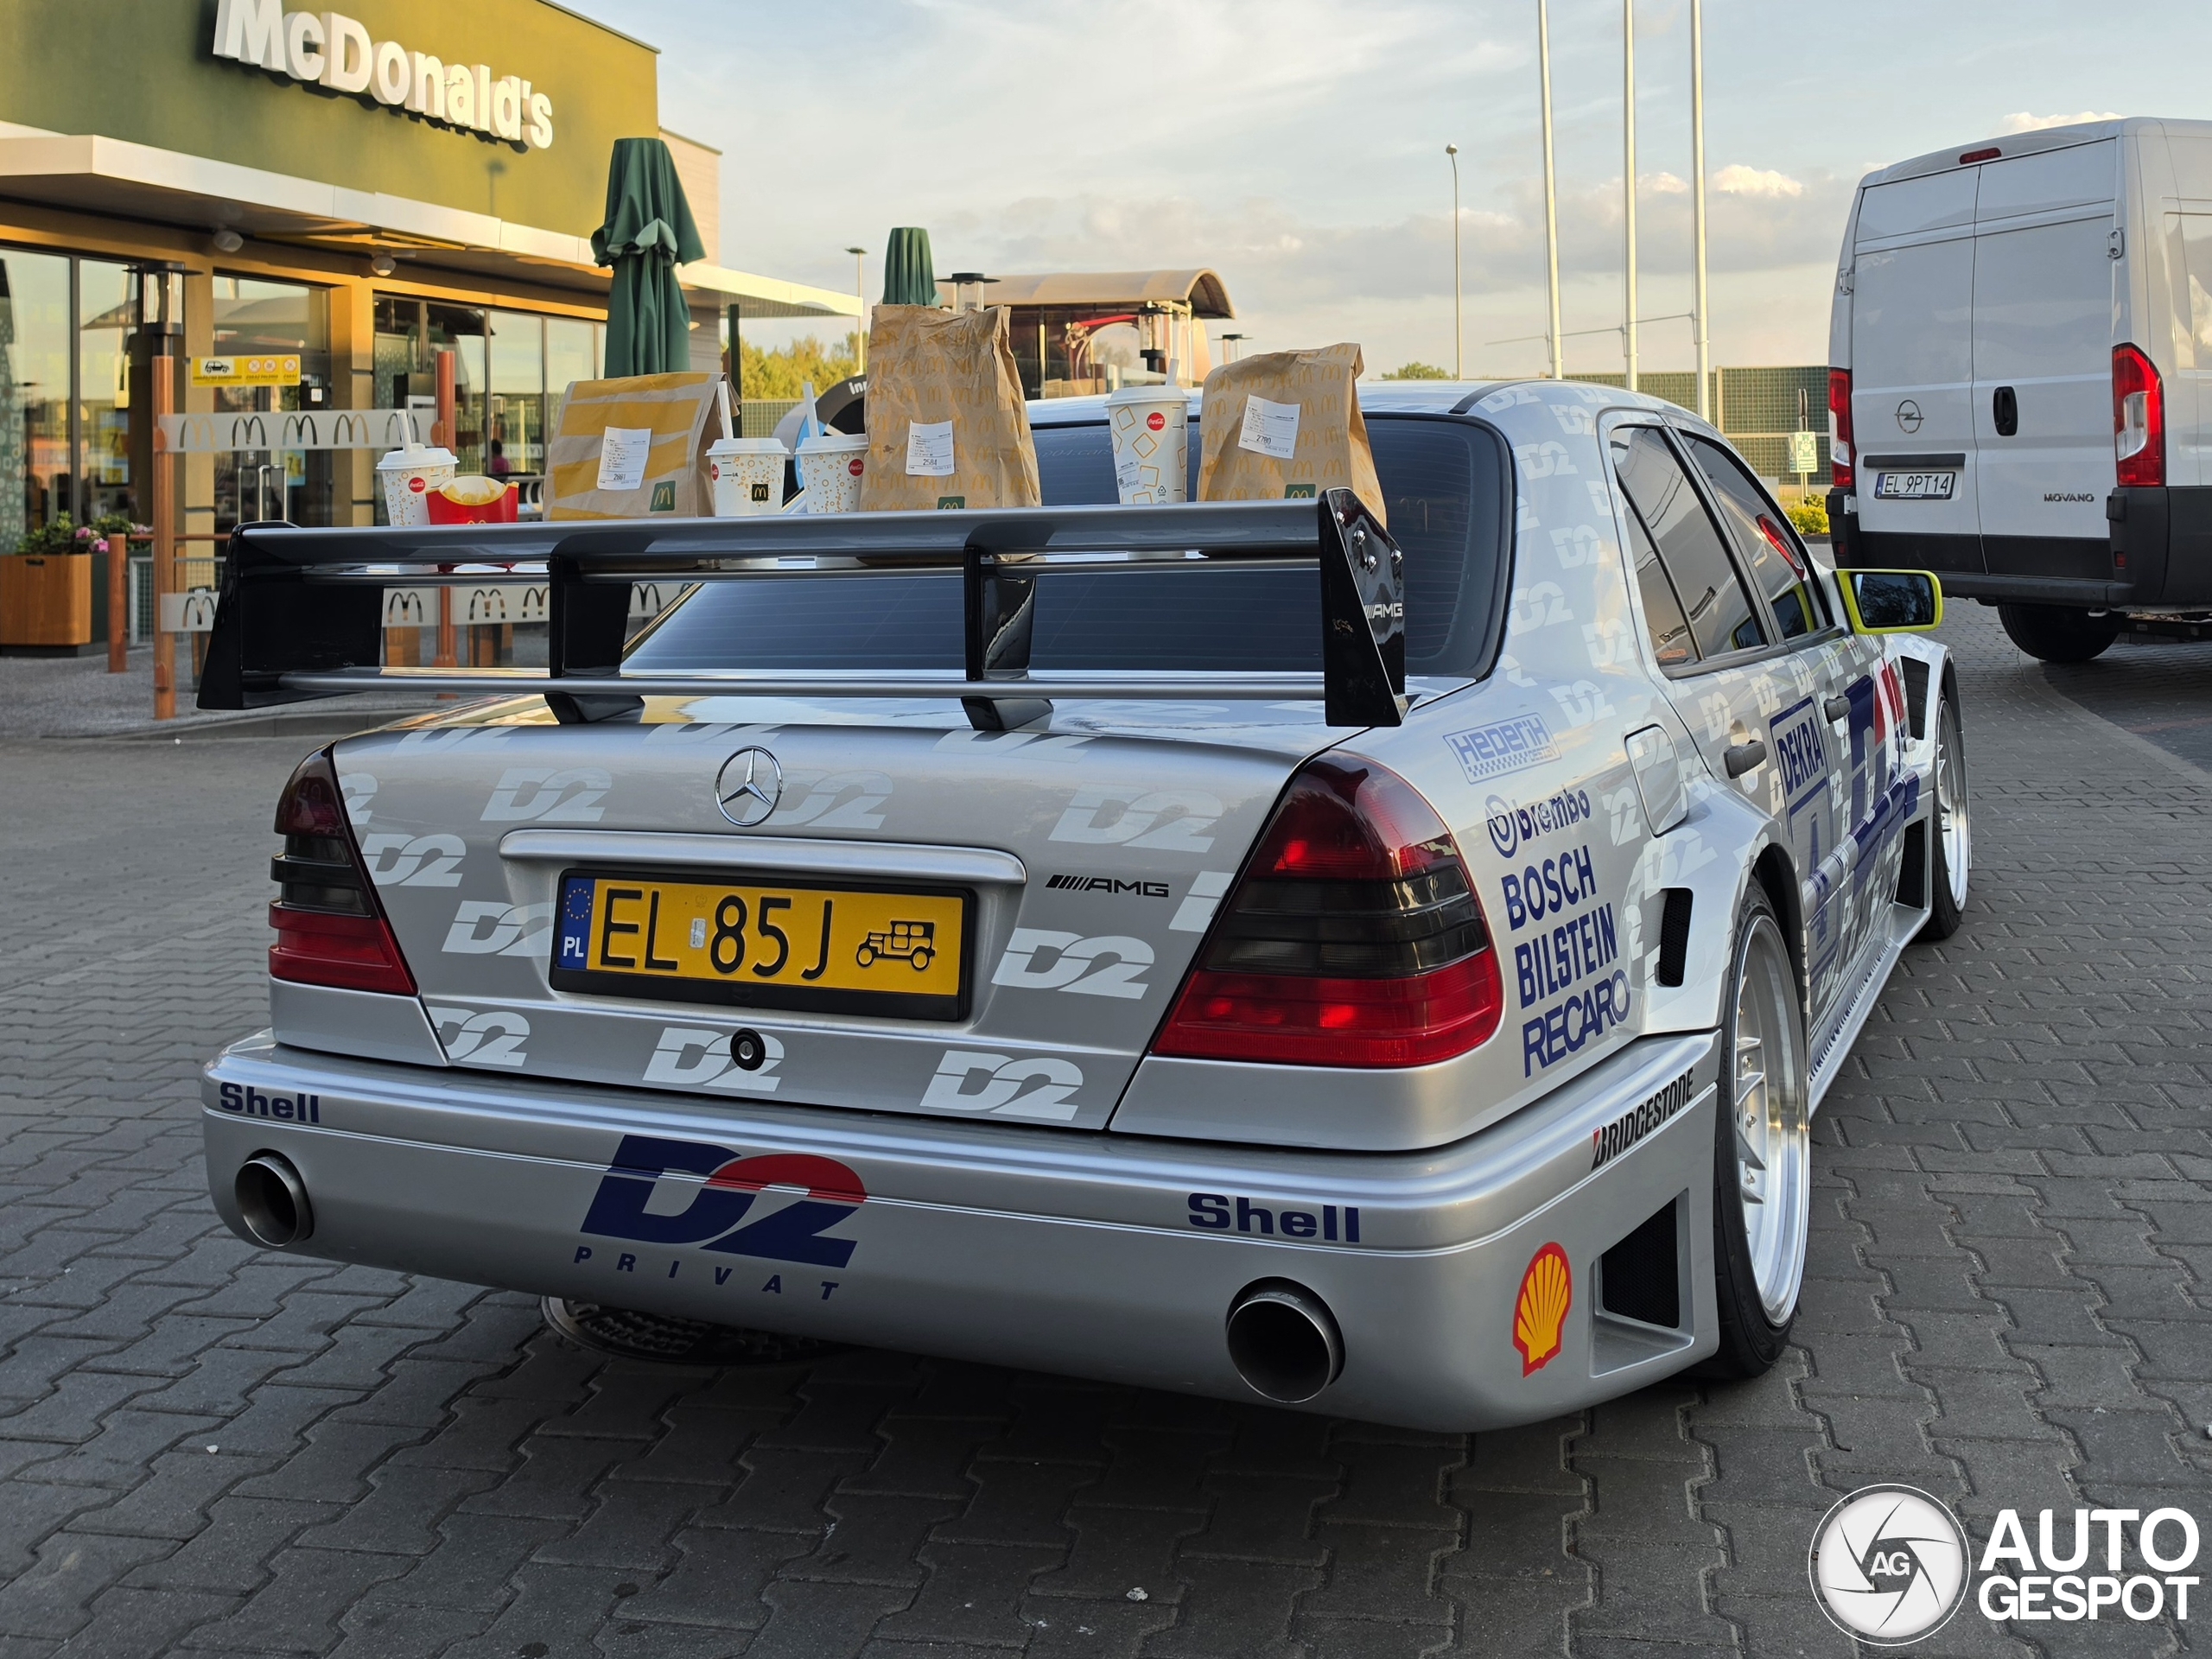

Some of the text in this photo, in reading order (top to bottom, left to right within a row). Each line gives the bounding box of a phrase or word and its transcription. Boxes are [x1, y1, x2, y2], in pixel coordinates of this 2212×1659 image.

[213, 0, 553, 149] McDonald's
[1513, 441, 1579, 480] D2
[1885, 475, 1949, 493] EL 9PT14
[2044, 493, 2095, 503] MOVANO
[1372, 602, 1403, 619] AMG
[1507, 582, 1574, 637] D2
[1777, 715, 1824, 796] DEKRA
[480, 767, 612, 822] D2
[1048, 781, 1224, 853] D2
[1518, 788, 1591, 843] brembo
[360, 833, 467, 887] D2
[1500, 844, 1597, 931] BOSCH
[1085, 878, 1170, 899] AMG
[563, 936, 584, 958] PL
[600, 887, 834, 981] EL 85J
[1514, 902, 1618, 1009] BILSTEIN
[991, 927, 1155, 1000] D2
[1522, 969, 1630, 1079] RECARO
[643, 1027, 785, 1092] D2
[919, 1050, 1084, 1121] D2
[219, 1082, 321, 1124] Shell
[1591, 1066, 1694, 1173] BRIDGESTONE
[580, 1134, 868, 1269] D2
[1186, 1192, 1361, 1244] Shell
[573, 1246, 840, 1300] PRIVAT
